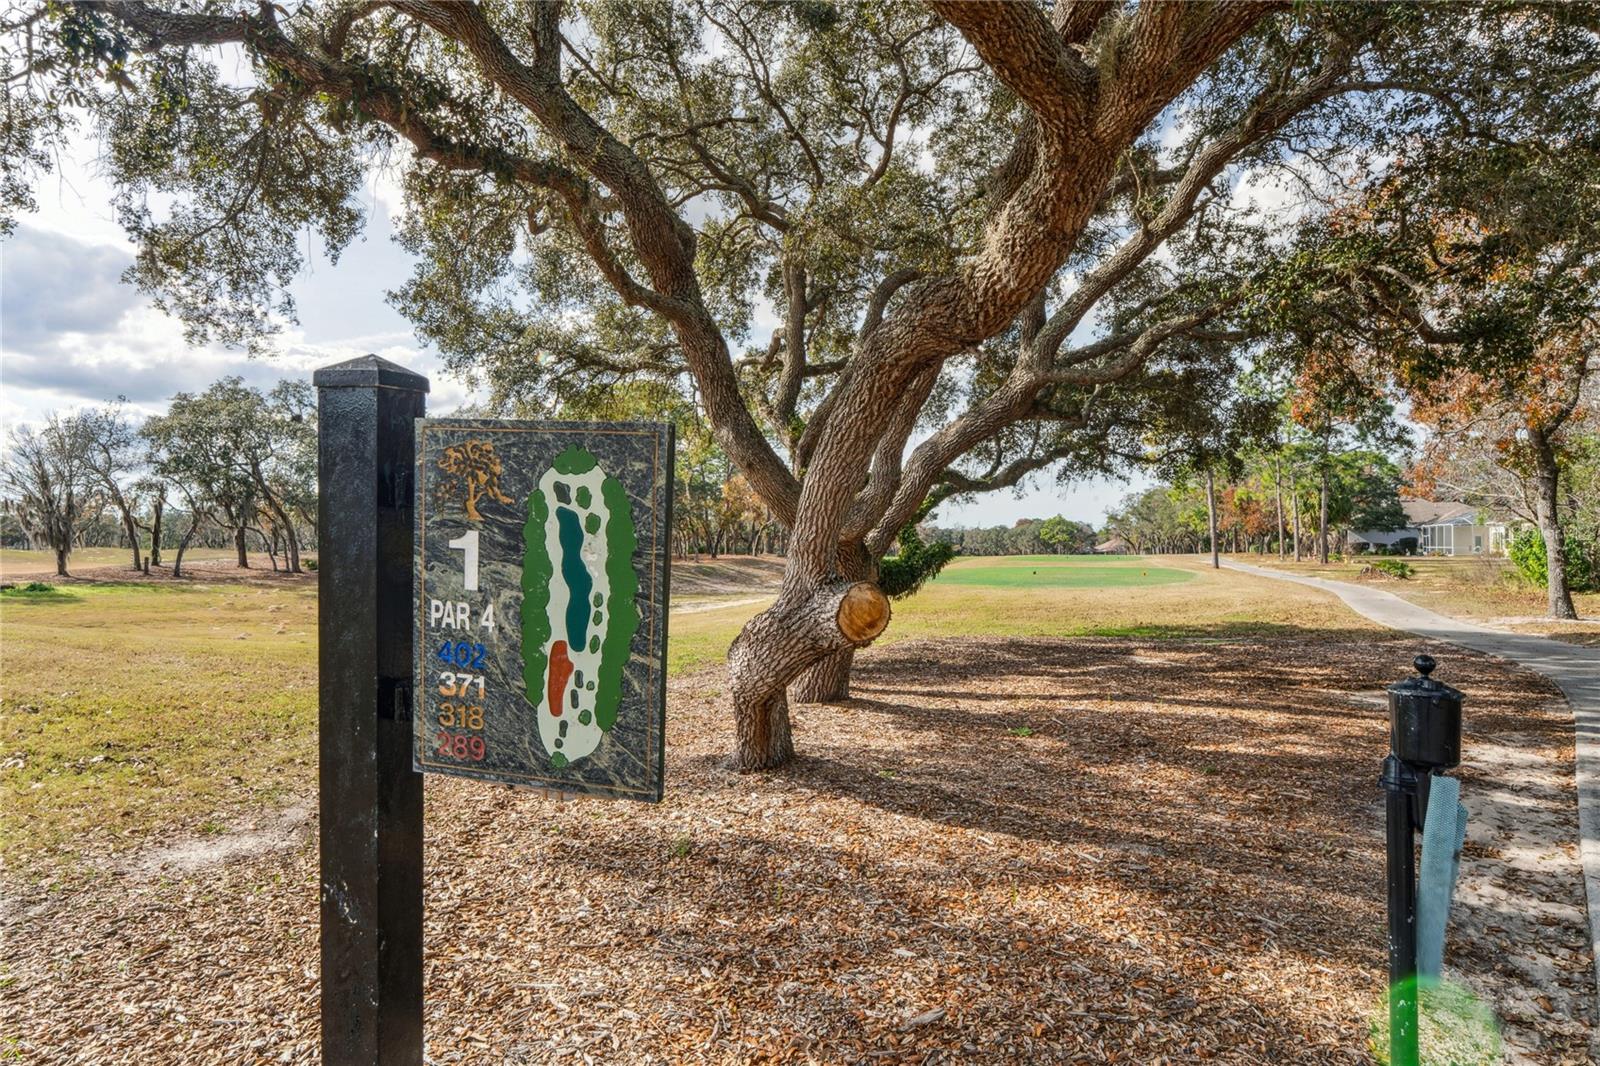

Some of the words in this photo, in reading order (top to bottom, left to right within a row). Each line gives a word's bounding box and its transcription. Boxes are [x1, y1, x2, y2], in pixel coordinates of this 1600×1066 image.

[449, 530, 479, 591] 1
[430, 600, 470, 631] PAR
[481, 604, 495, 633] 4
[437, 640, 487, 670] 402
[438, 671, 486, 700] 371
[438, 703, 484, 731] 318
[437, 732, 486, 761] 289
